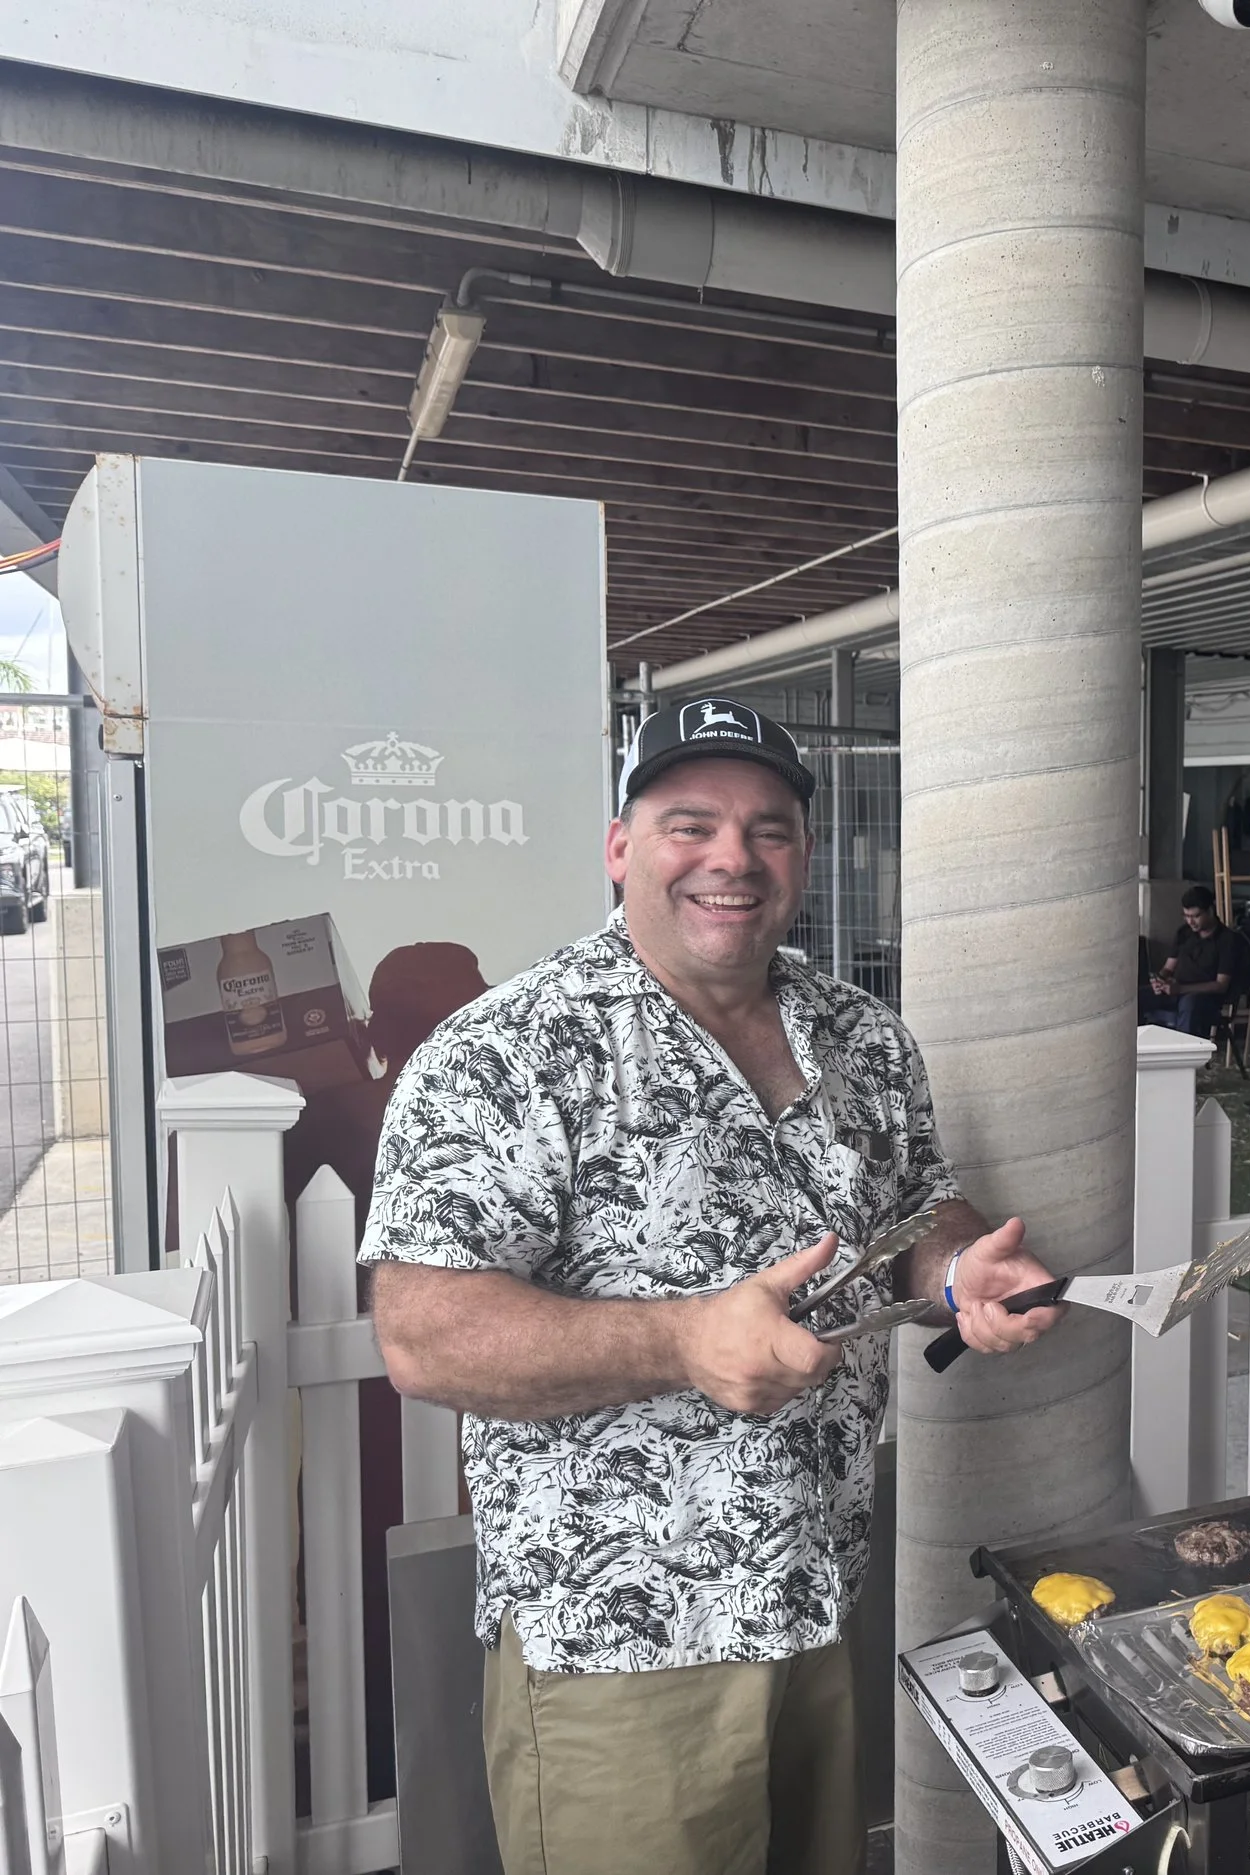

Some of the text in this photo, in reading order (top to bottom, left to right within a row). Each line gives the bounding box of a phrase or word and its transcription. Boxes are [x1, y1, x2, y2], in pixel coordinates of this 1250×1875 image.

[689, 730, 718, 741] JOHN
[239, 775, 531, 866] Corona
[341, 847, 441, 880] Extra
[222, 973, 271, 994] Corona
[1052, 1812, 1122, 1841] BARBECUE
[1055, 1824, 1117, 1853] HEATLIE
